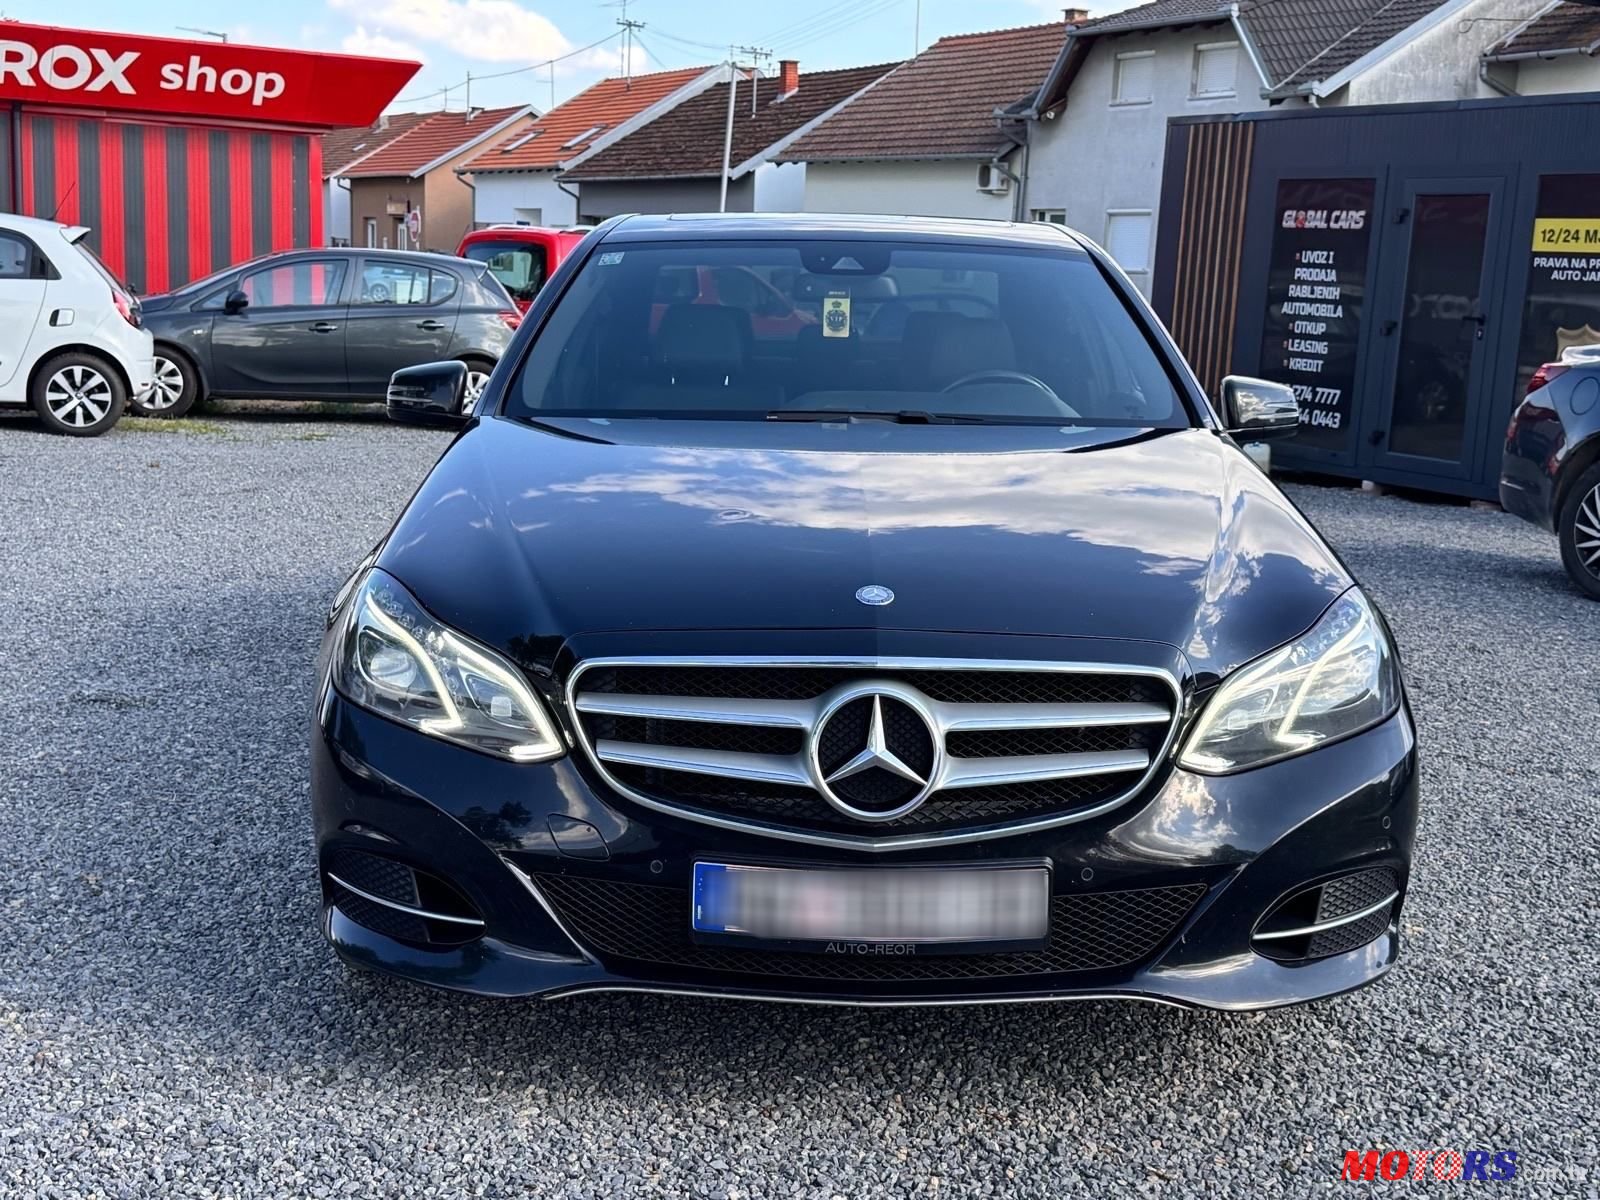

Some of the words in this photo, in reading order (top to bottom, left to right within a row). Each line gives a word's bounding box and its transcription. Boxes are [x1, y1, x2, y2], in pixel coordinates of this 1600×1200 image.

[160, 55, 286, 106] shop
[1329, 210, 1366, 229] CARS
[1541, 228, 1580, 244] 12/24
[1584, 229, 1600, 244] M
[1301, 250, 1328, 264] UVOZ
[1328, 251, 1335, 264] I
[1533, 257, 1569, 268] PRAVA
[1570, 258, 1587, 269] NA
[1294, 267, 1337, 282] PRODAJA
[1551, 270, 1581, 281] AUTO
[1288, 284, 1341, 300] RABLJENIH
[1281, 302, 1343, 318] AUTOMOBILA
[1294, 320, 1326, 335] OTKUP
[1288, 339, 1328, 354] LEASING
[1289, 357, 1324, 372] KREDIT
[1315, 387, 1341, 405] 7777
[1311, 410, 1341, 428] 0443
[825, 942, 916, 955] AUTO-REOR
